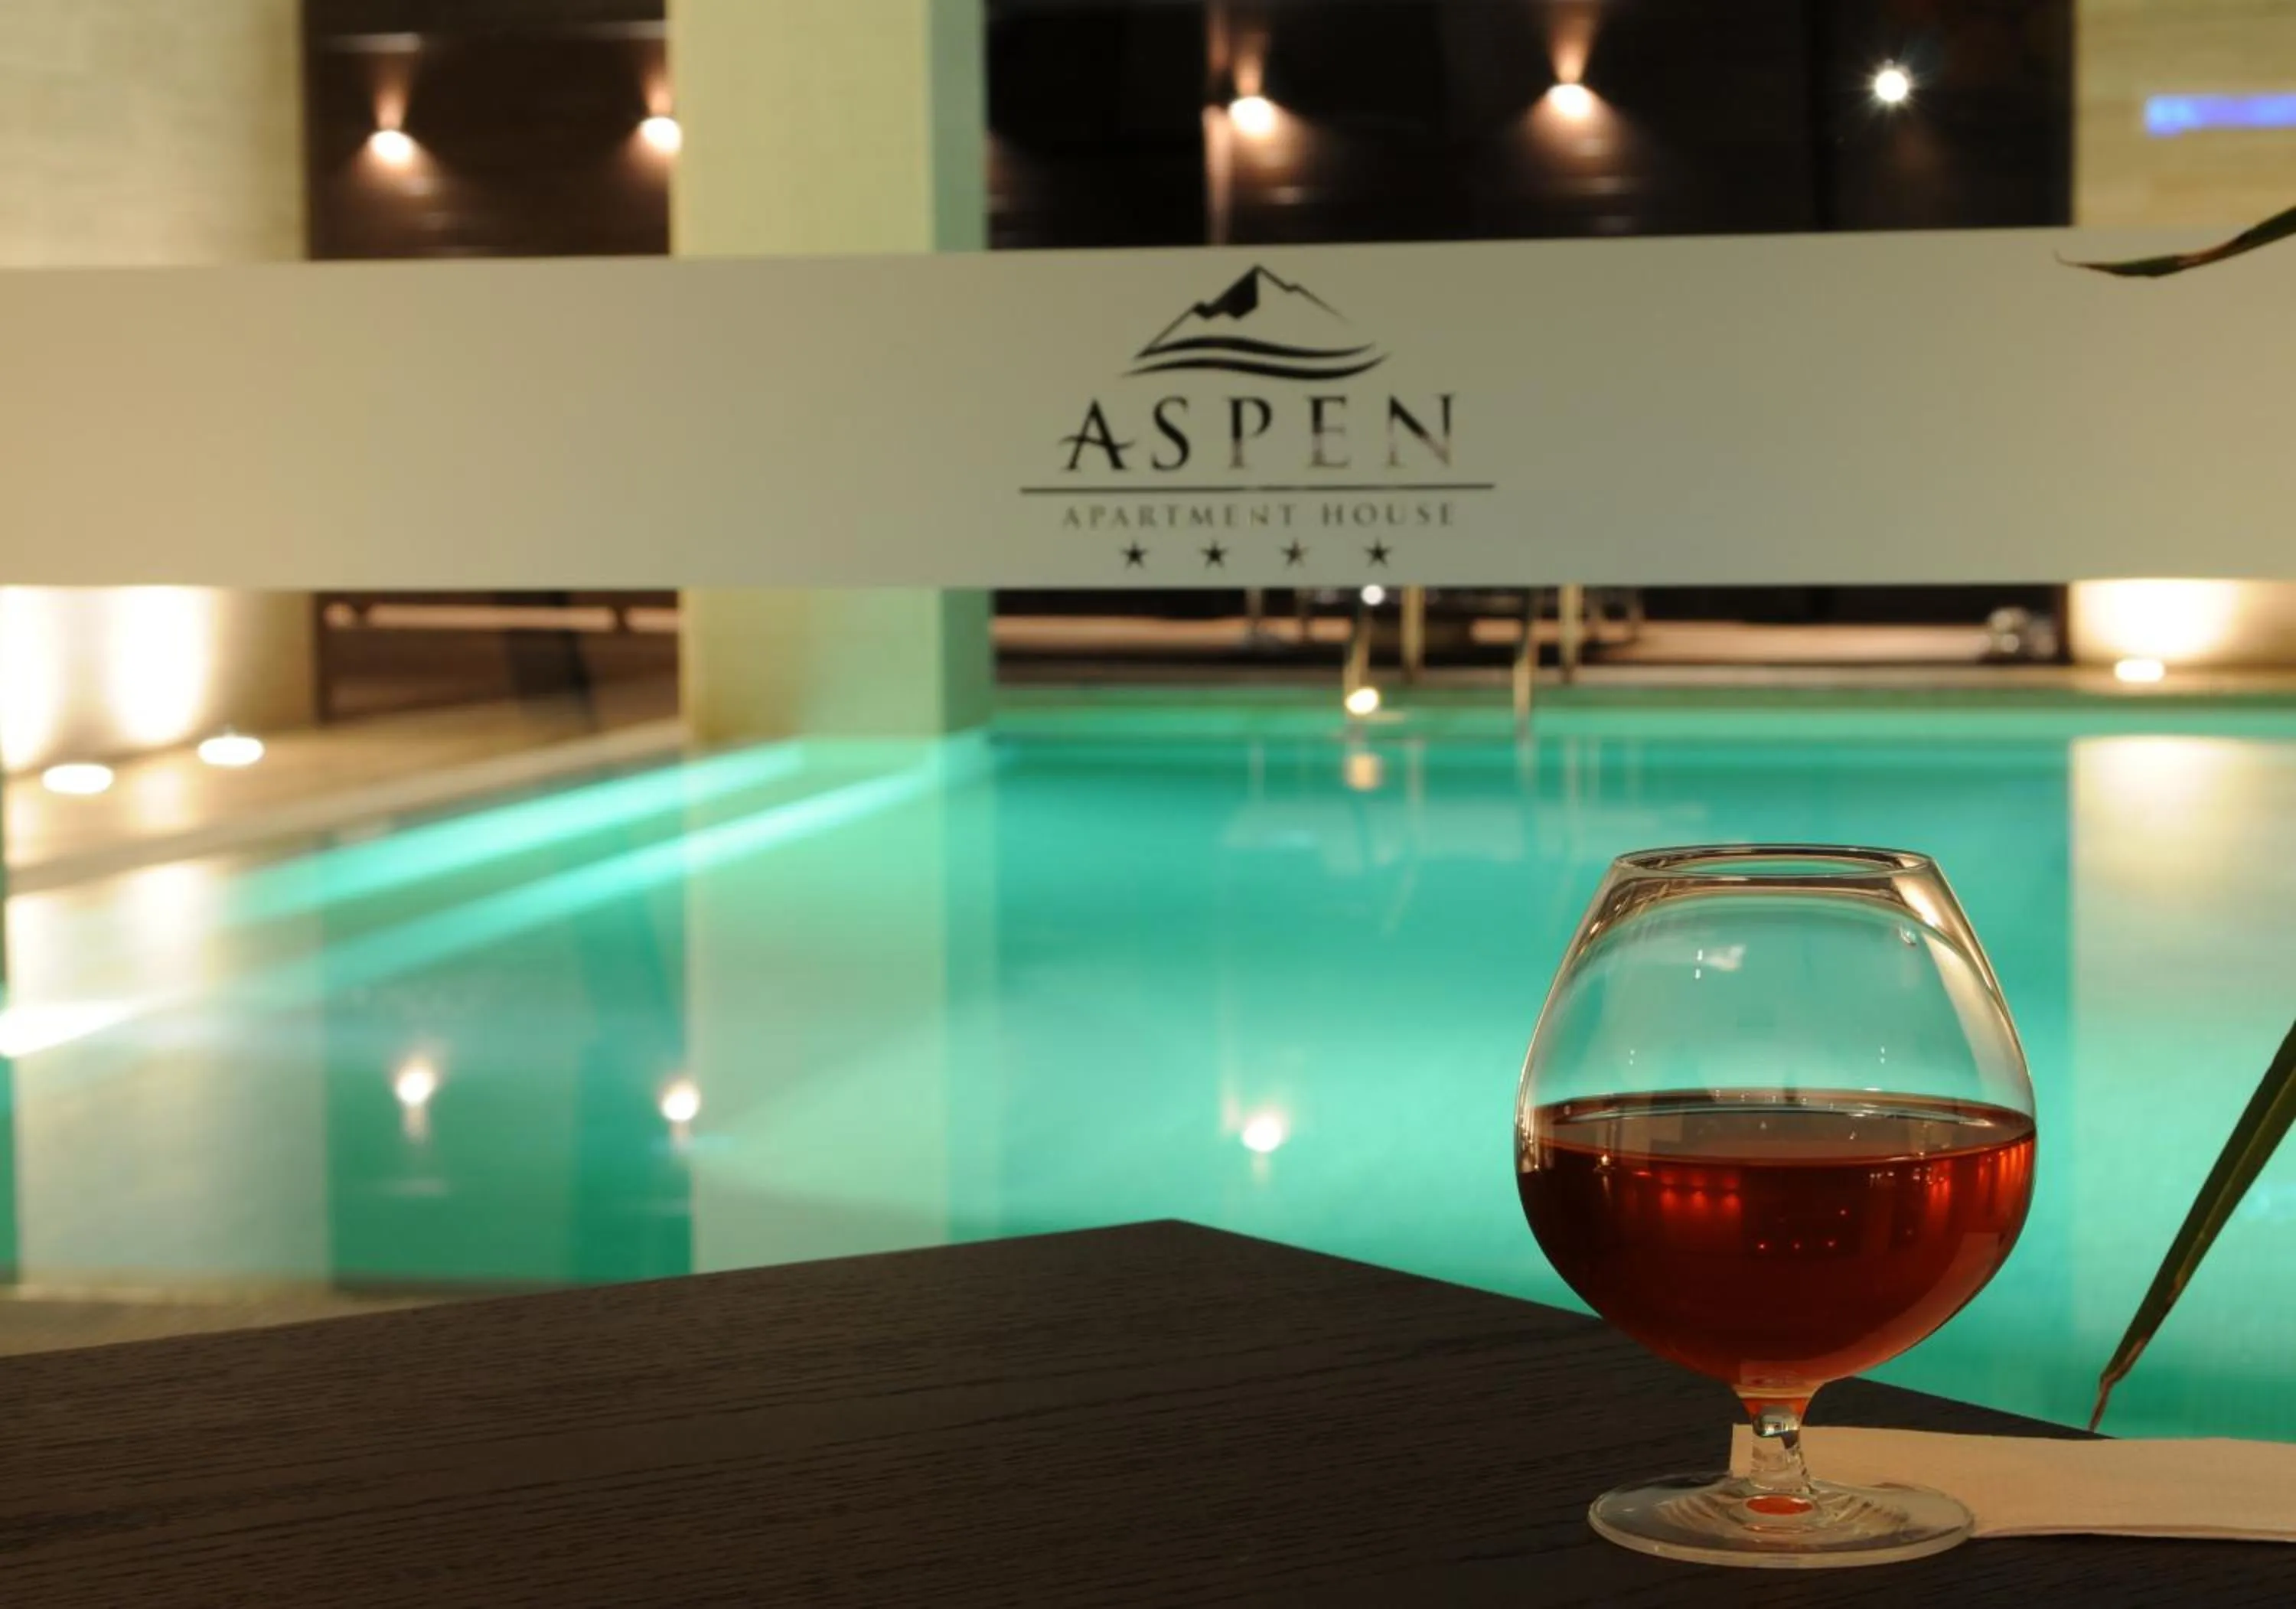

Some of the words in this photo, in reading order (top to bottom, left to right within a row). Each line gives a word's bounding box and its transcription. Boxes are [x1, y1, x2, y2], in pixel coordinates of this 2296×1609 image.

[1060, 393, 1455, 472] ASPEN
[1063, 504, 1295, 528] APARTMENT
[1322, 501, 1455, 527] HOUSE
